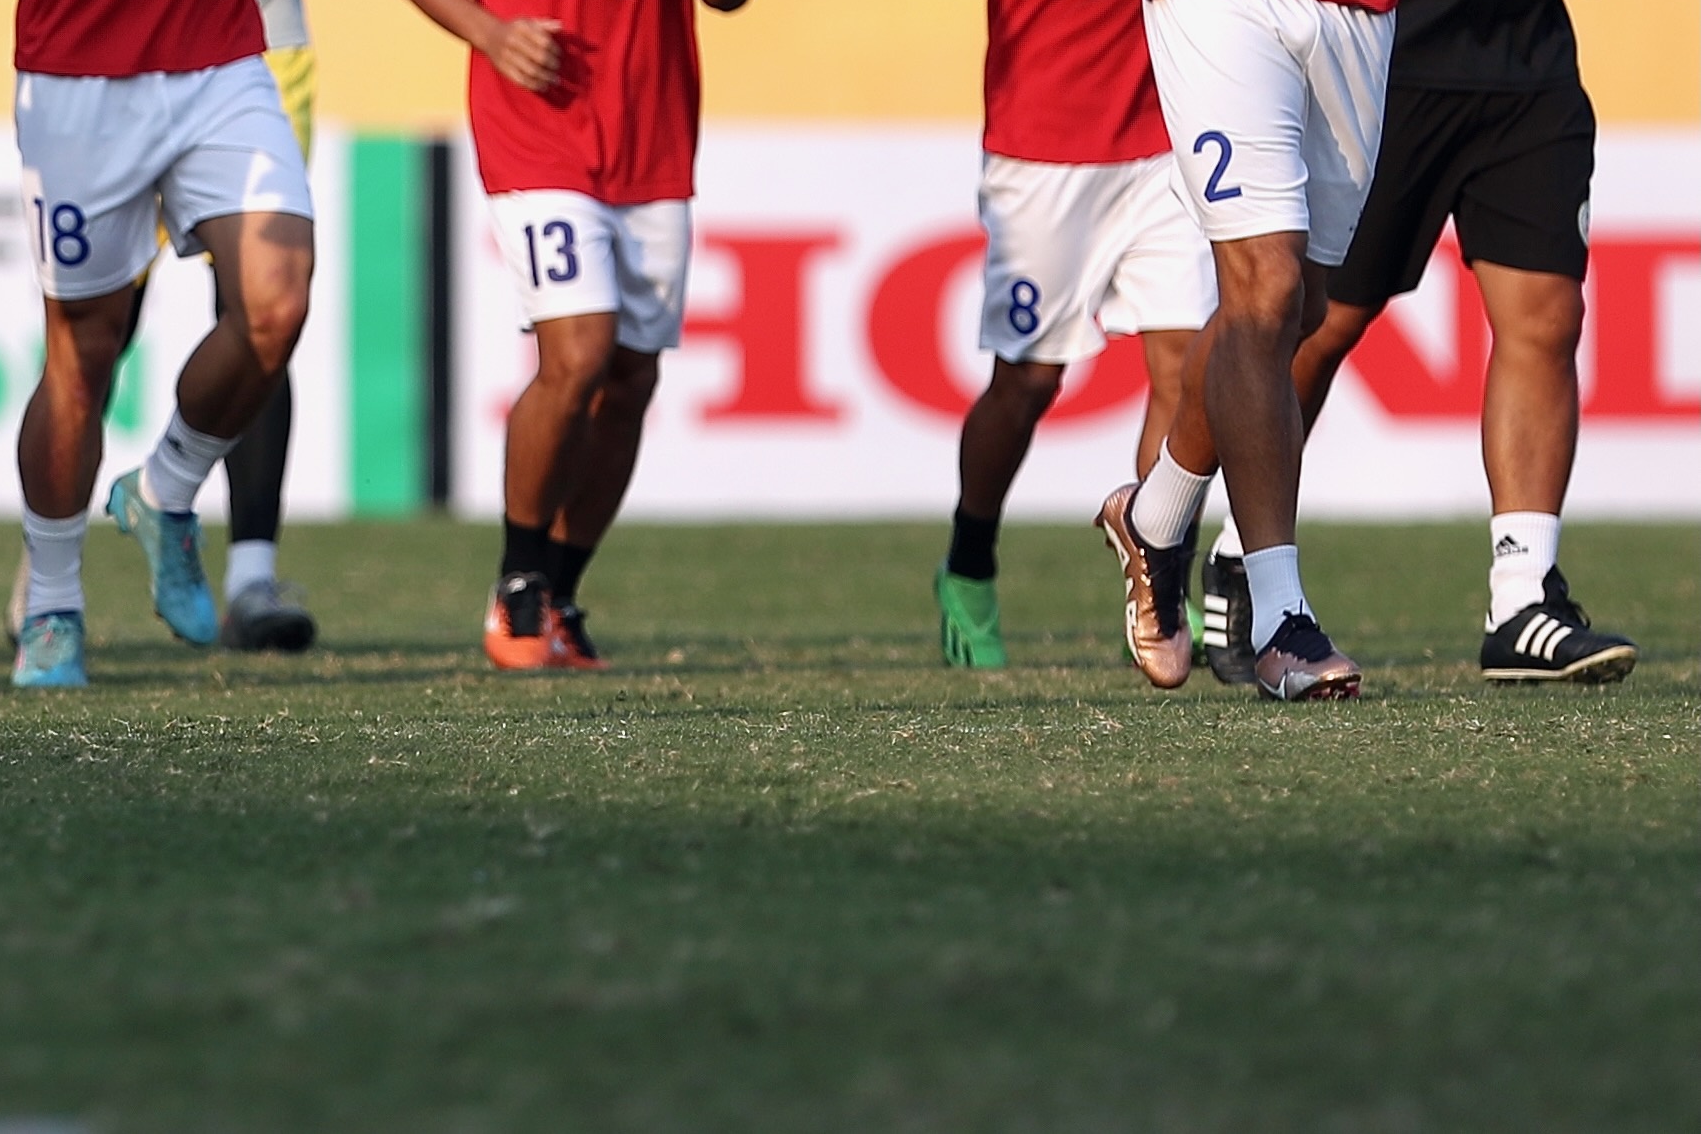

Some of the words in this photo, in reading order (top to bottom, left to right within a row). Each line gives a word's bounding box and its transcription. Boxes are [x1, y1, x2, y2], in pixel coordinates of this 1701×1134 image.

[1193, 130, 1243, 203] 2
[33, 197, 90, 266] 18
[524, 220, 578, 287] 13
[1009, 280, 1039, 336] 8
